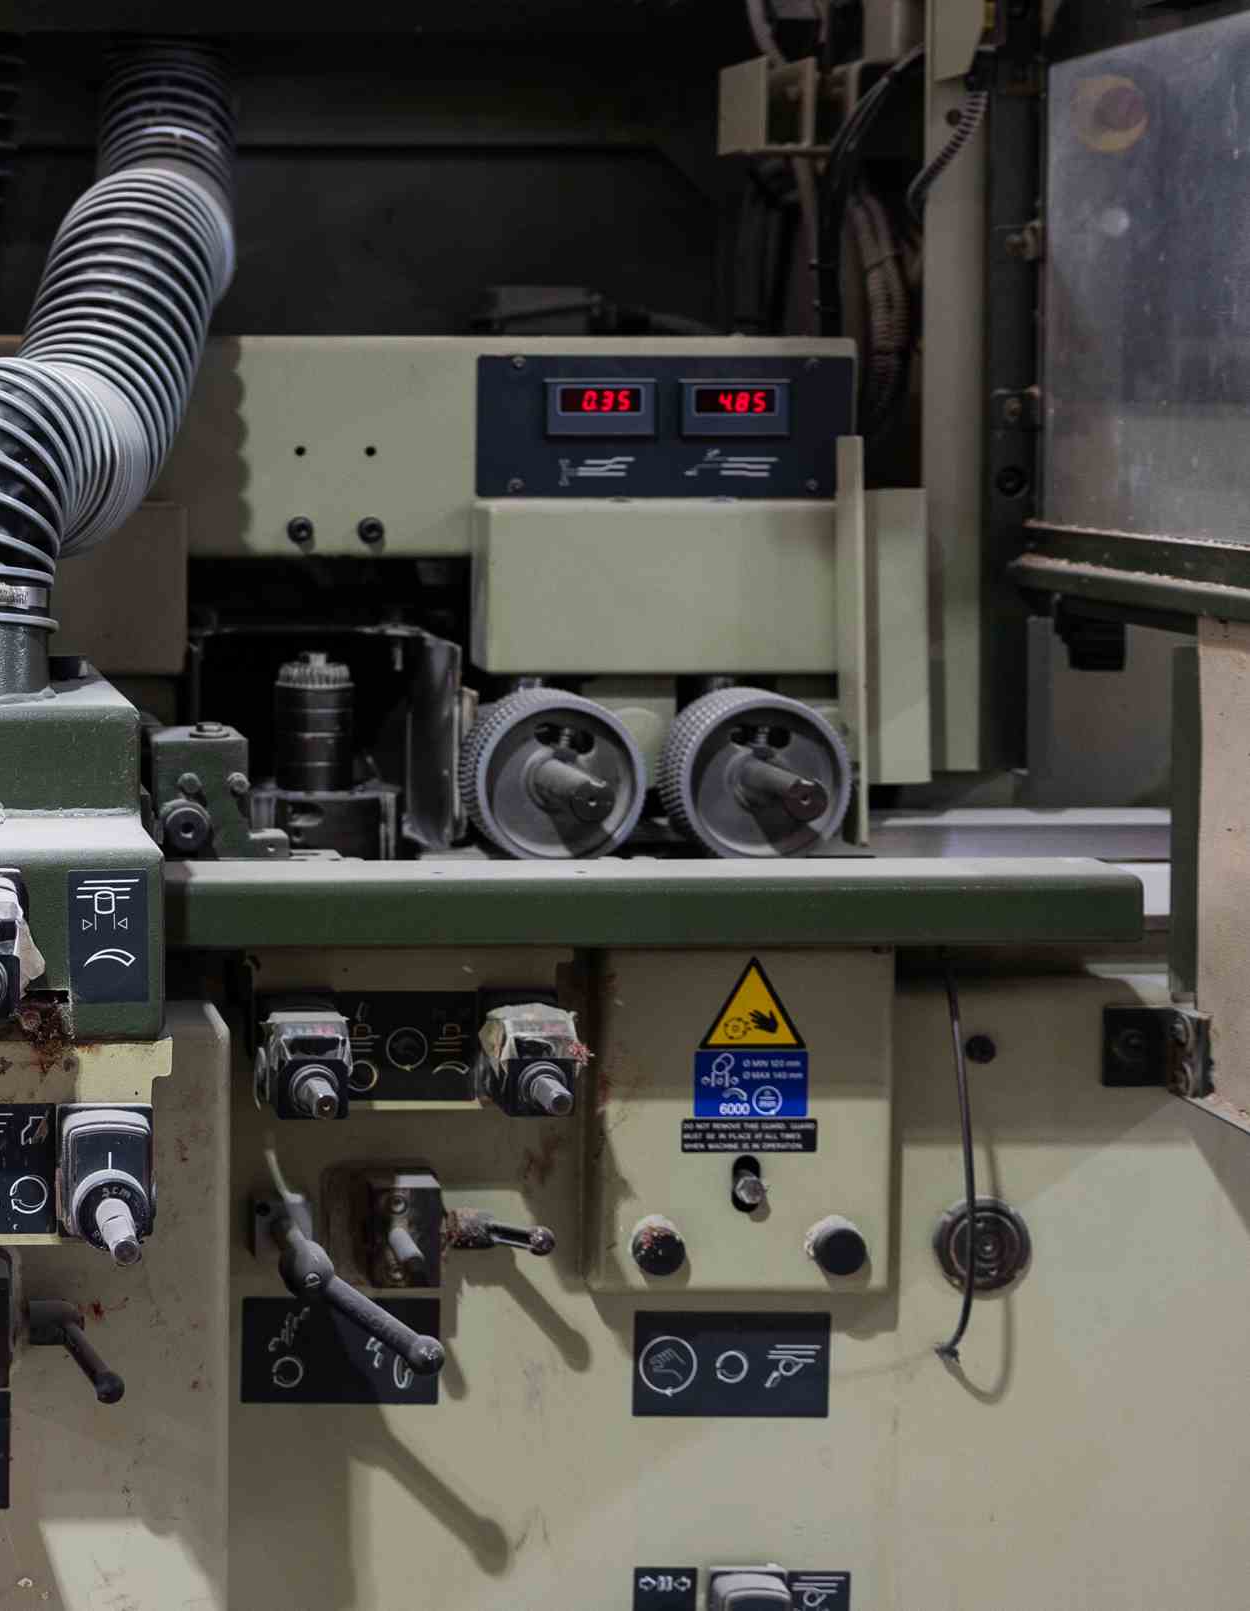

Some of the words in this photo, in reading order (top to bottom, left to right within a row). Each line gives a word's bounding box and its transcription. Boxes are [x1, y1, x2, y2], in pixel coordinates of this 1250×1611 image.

[752, 1059, 769, 1067] MIN
[752, 1071, 771, 1080] MAX
[719, 1103, 751, 1116] 6000
[695, 1122, 710, 1130] NOT
[712, 1122, 741, 1130] REMOVE
[743, 1122, 759, 1130] THIS
[683, 1132, 703, 1140] MUST
[706, 1132, 716, 1140] BE
[718, 1132, 727, 1140] IN
[728, 1132, 751, 1140] PLACE
[754, 1132, 763, 1140] AT
[764, 1132, 779, 1140] ALL
[683, 1142, 705, 1150] WHEN
[707, 1142, 739, 1150] MACHINE
[741, 1142, 750, 1150] IS
[751, 1142, 761, 1150] IN
